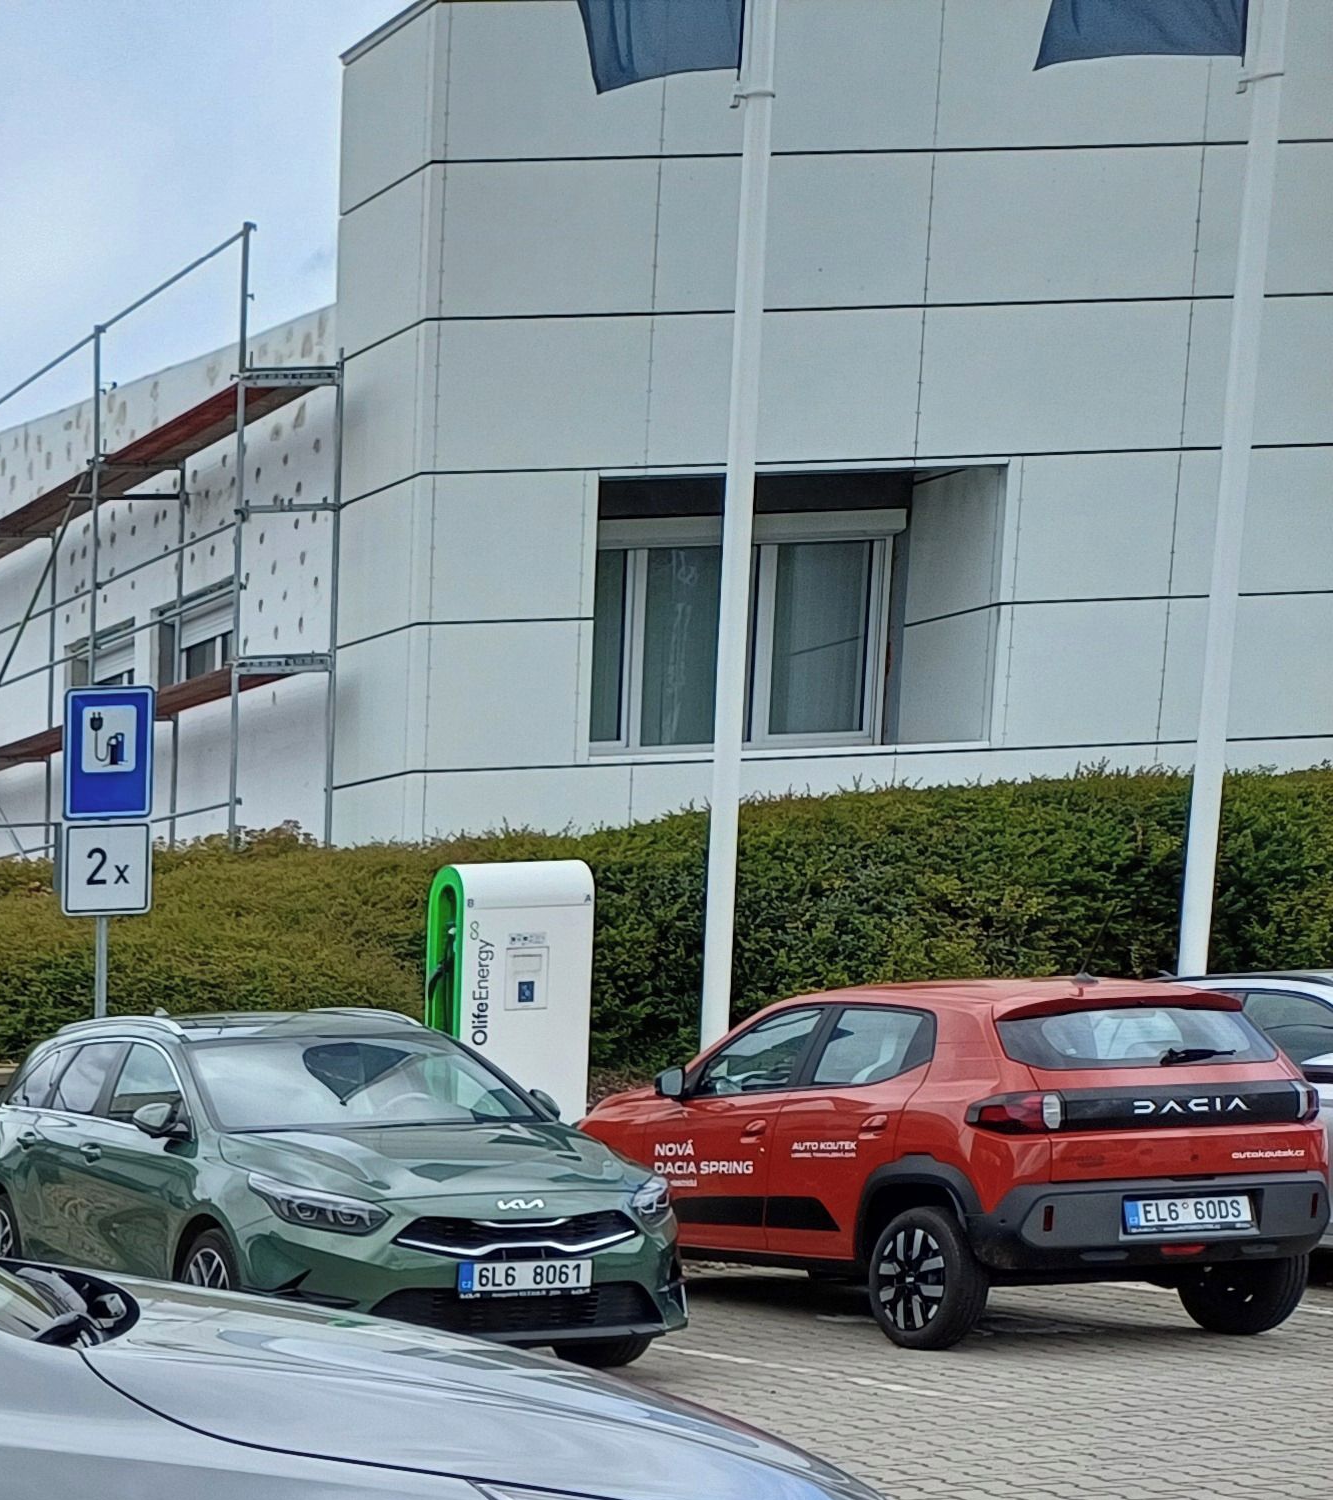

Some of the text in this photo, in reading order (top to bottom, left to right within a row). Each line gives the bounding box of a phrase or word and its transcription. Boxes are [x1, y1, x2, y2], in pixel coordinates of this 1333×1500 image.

[471, 938, 495, 1046] OlifeEnergy
[1134, 1096, 1251, 1115] DACIA
[654, 1139, 695, 1156] NOVÁ
[792, 1141, 857, 1150] AUTO KOUTEK
[654, 1160, 754, 1175] DACIA SPRING
[1142, 1201, 1180, 1223] EL6
[478, 1263, 582, 1287] 6L6 8061
